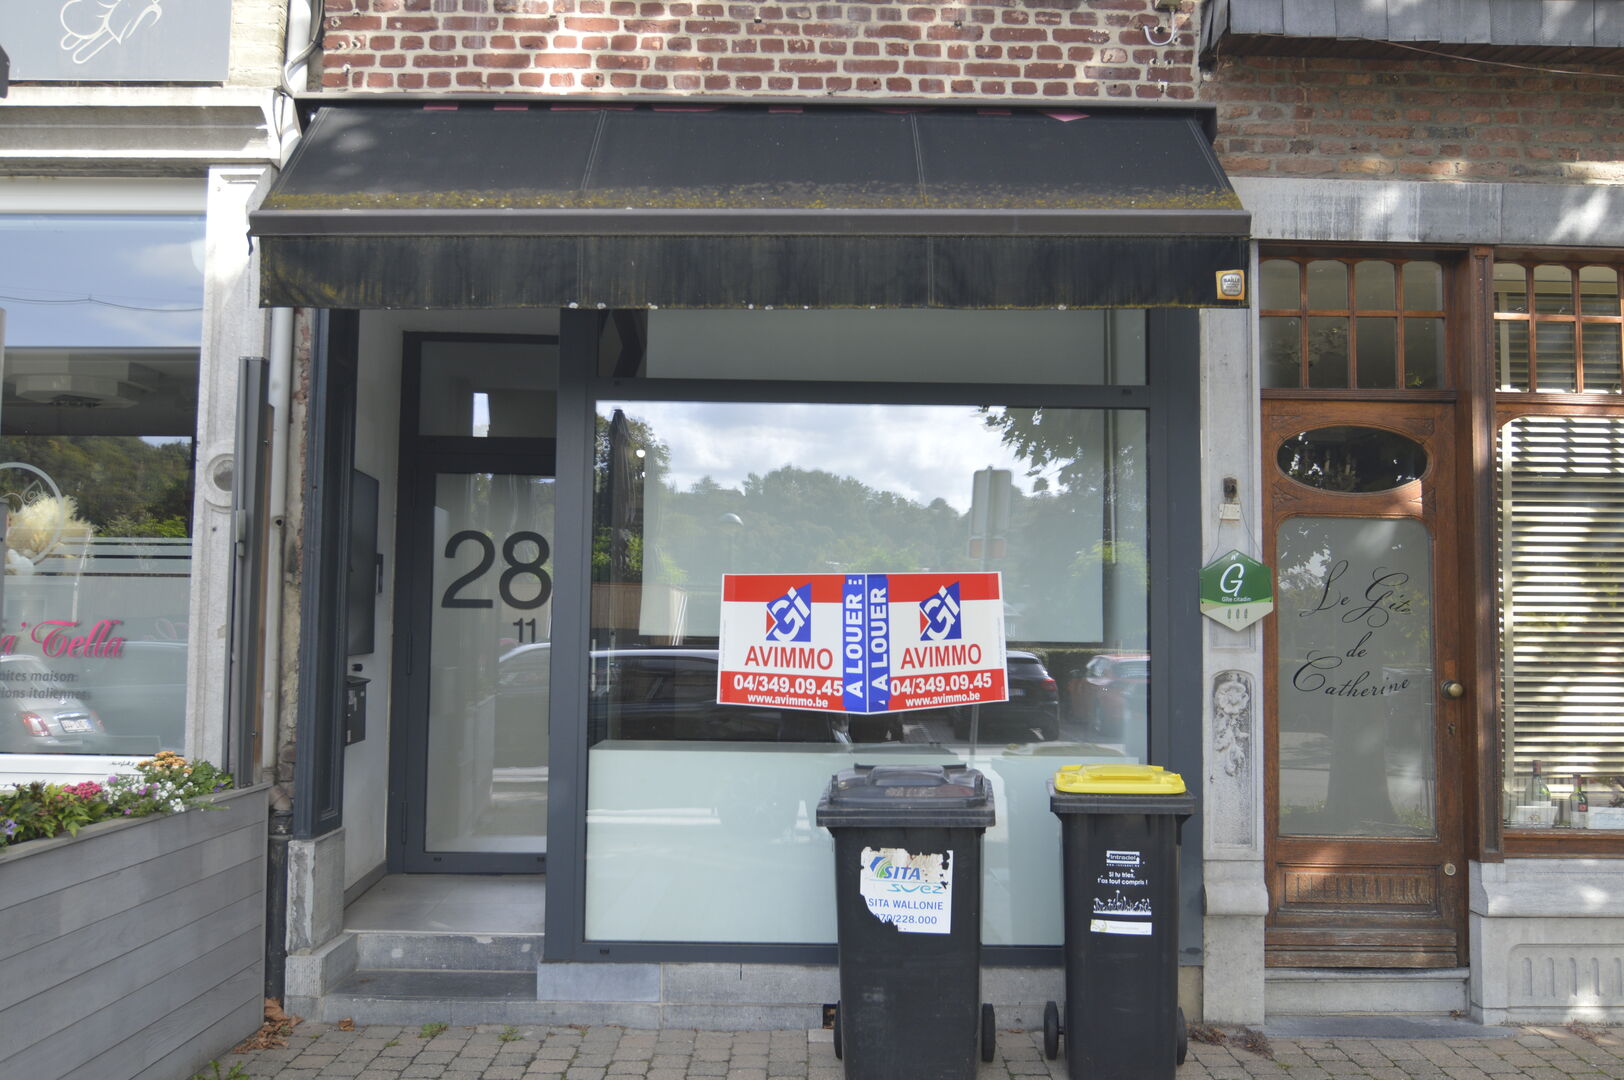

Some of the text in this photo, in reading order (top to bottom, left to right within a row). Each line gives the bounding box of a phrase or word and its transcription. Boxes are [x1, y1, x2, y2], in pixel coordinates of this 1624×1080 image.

[441, 530, 552, 610] 28
[1220, 563, 1245, 597] G
[1299, 560, 1351, 618] Le
[31, 618, 124, 658] Tella
[513, 618, 536, 643] 11
[870, 588, 888, 691] A LOUER
[744, 645, 833, 670] AVIMMO
[845, 593, 863, 698] A LOUER
[901, 643, 982, 670] AVIMMO
[1346, 631, 1373, 658] de
[733, 674, 844, 697] 04/349.09.45
[890, 672, 992, 696] 04/349.09.45
[1293, 650, 1410, 697] Catherine
[747, 693, 829, 708] www.avimmo.be
[905, 691, 981, 707] www.avimmo.be
[883, 865, 921, 881] SITA
[868, 898, 944, 911] SITA WALLONIE
